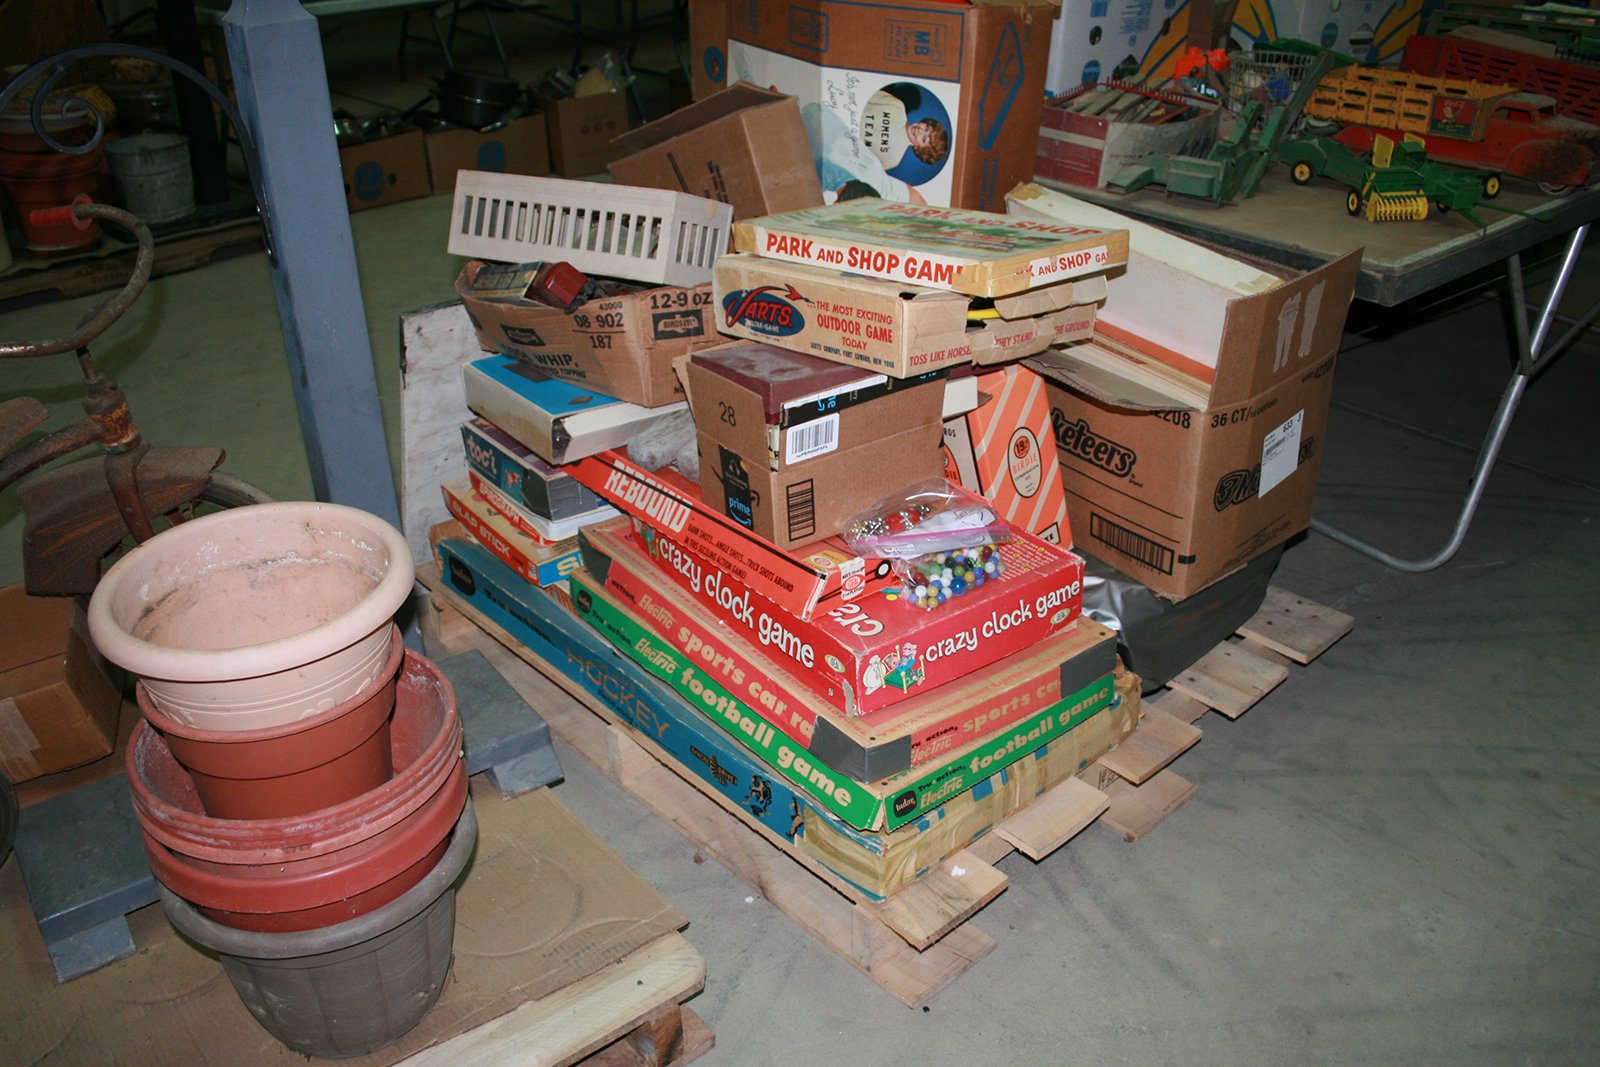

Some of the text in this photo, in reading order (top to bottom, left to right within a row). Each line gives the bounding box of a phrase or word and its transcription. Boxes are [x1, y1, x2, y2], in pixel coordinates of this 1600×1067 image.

[880, 111, 891, 153] WOMEN'S
[1007, 219, 1102, 237] SHOP
[766, 232, 964, 285] PARK AND SHOP GAM
[1037, 262, 1058, 277] AND
[1059, 251, 1093, 271] SHOP
[599, 301, 623, 312] 43000
[651, 291, 689, 310] 12-9
[573, 312, 624, 329] 08 902
[832, 304, 854, 317] MOST
[856, 309, 893, 325] EXCITING
[1065, 319, 1090, 333] GROUND
[817, 313, 893, 344] OUTDOOR GAME
[1012, 331, 1034, 345] STAND
[589, 335, 612, 350] 187
[842, 337, 867, 351] TODAY
[873, 357, 882, 365] NEW
[884, 360, 895, 369] YORK
[909, 353, 928, 367] TOSS
[930, 350, 945, 363] LIKE
[719, 401, 737, 427] 28
[1211, 413, 1228, 429] 36
[1012, 453, 1037, 474] BIRDIE
[479, 482, 520, 524] SPIROGRAPH
[603, 459, 694, 533] REBOUND
[729, 497, 751, 516] prime
[452, 500, 511, 558] SLAP STICK
[759, 565, 775, 582] SHOTS
[774, 574, 794, 593] ABOUND
[659, 538, 815, 669] crazy clock game
[925, 580, 1081, 663] crazy clock game
[639, 593, 679, 630] Electric
[677, 626, 746, 686] sports
[748, 681, 788, 716] car
[566, 646, 671, 738] HOCKEY
[634, 637, 681, 674] Electric
[680, 667, 776, 748] football
[776, 745, 853, 807] game
[962, 692, 1031, 733] sports
[896, 687, 1109, 812] tudor Electric football game
